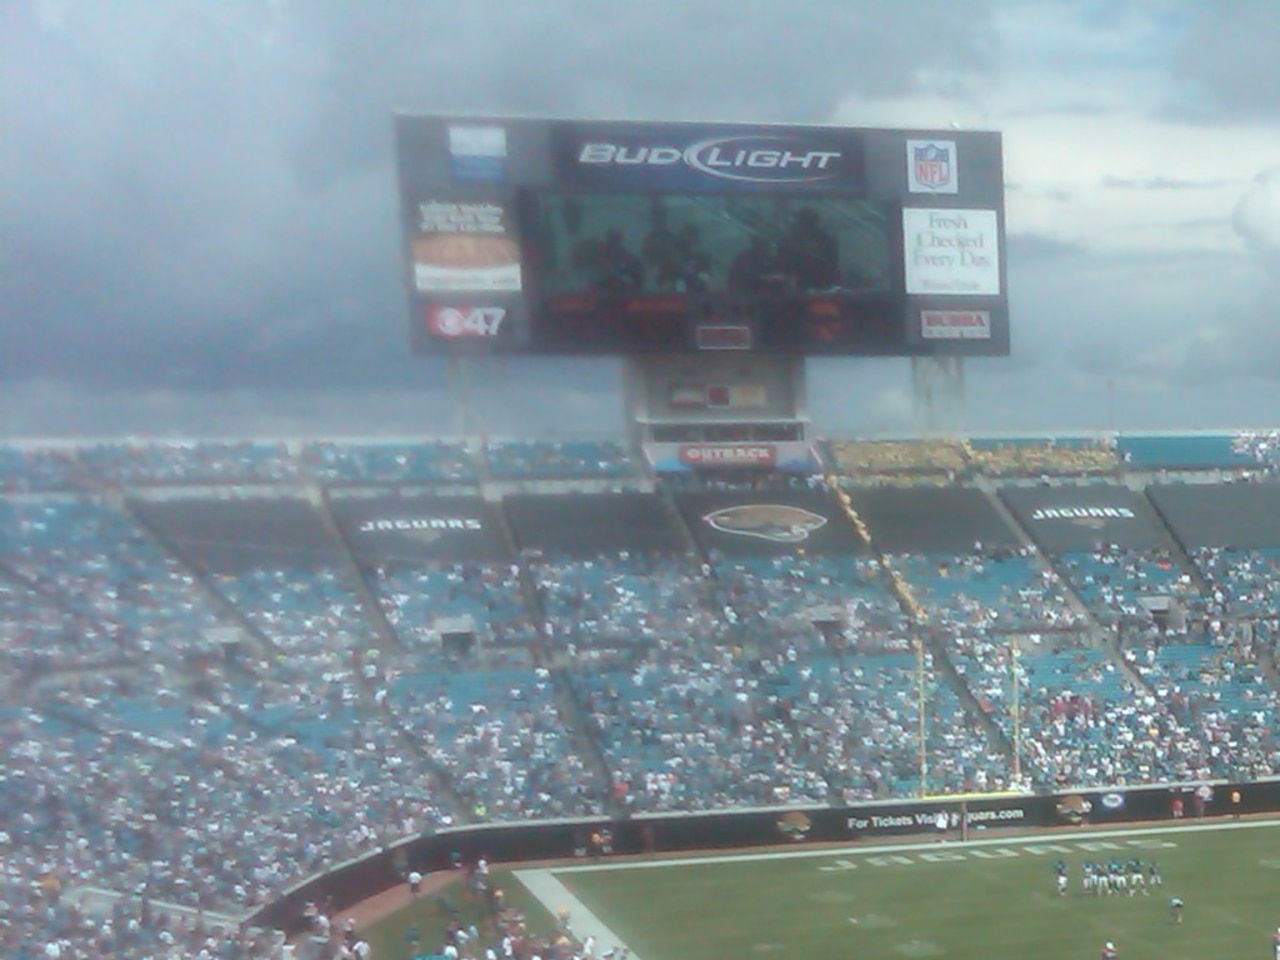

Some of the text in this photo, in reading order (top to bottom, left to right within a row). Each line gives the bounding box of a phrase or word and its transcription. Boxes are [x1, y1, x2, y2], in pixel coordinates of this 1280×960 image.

[579, 144, 841, 168] BUD LIGHT
[917, 162, 947, 183] NFL
[930, 213, 968, 229] Fresh
[464, 306, 505, 335] 47
[686, 447, 771, 462] OUTBACK
[1032, 507, 1135, 519] JAGUARS
[360, 519, 482, 532] JAGUARS
[847, 817, 869, 829] For
[870, 814, 914, 828] Tickets
[818, 838, 1178, 872] JAGUARS
